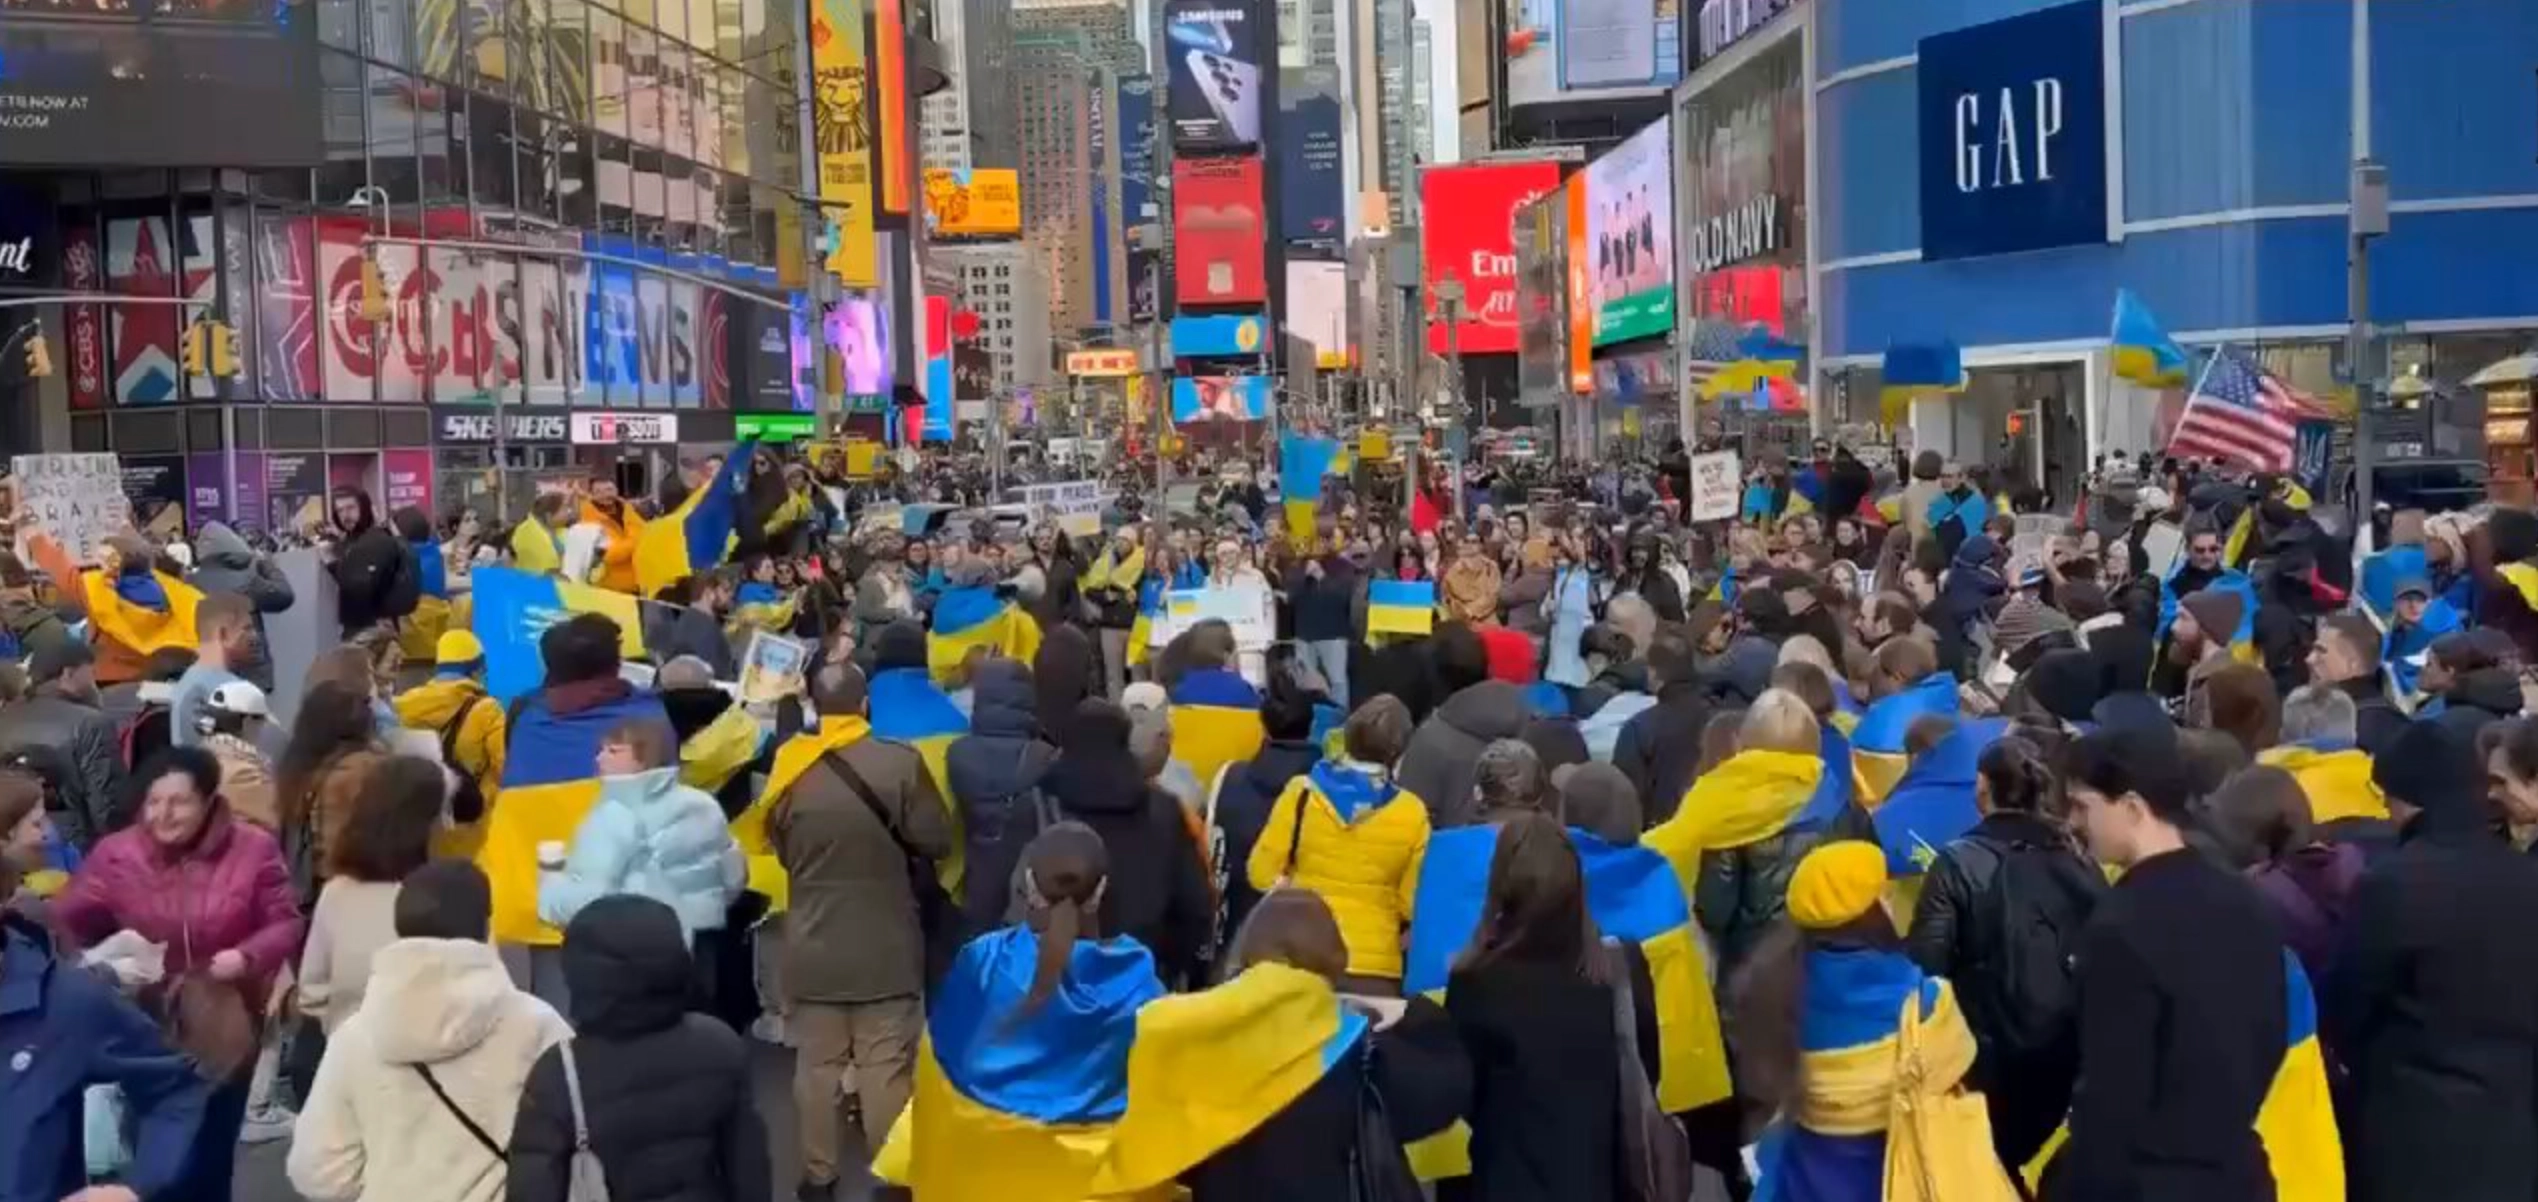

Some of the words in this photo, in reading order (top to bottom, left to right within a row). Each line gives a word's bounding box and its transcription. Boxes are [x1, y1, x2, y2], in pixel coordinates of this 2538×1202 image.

[1177, 8, 1245, 23] SAMSUNG
[30, 96, 68, 109] NOW
[70, 97, 89, 109] AT
[1955, 77, 2063, 193] GAP
[1694, 217, 1721, 272] OLD
[1726, 195, 1777, 260] NAVY
[78, 322, 95, 372] CBS
[400, 266, 522, 380] CBS
[442, 415, 567, 440] SKEHERS
